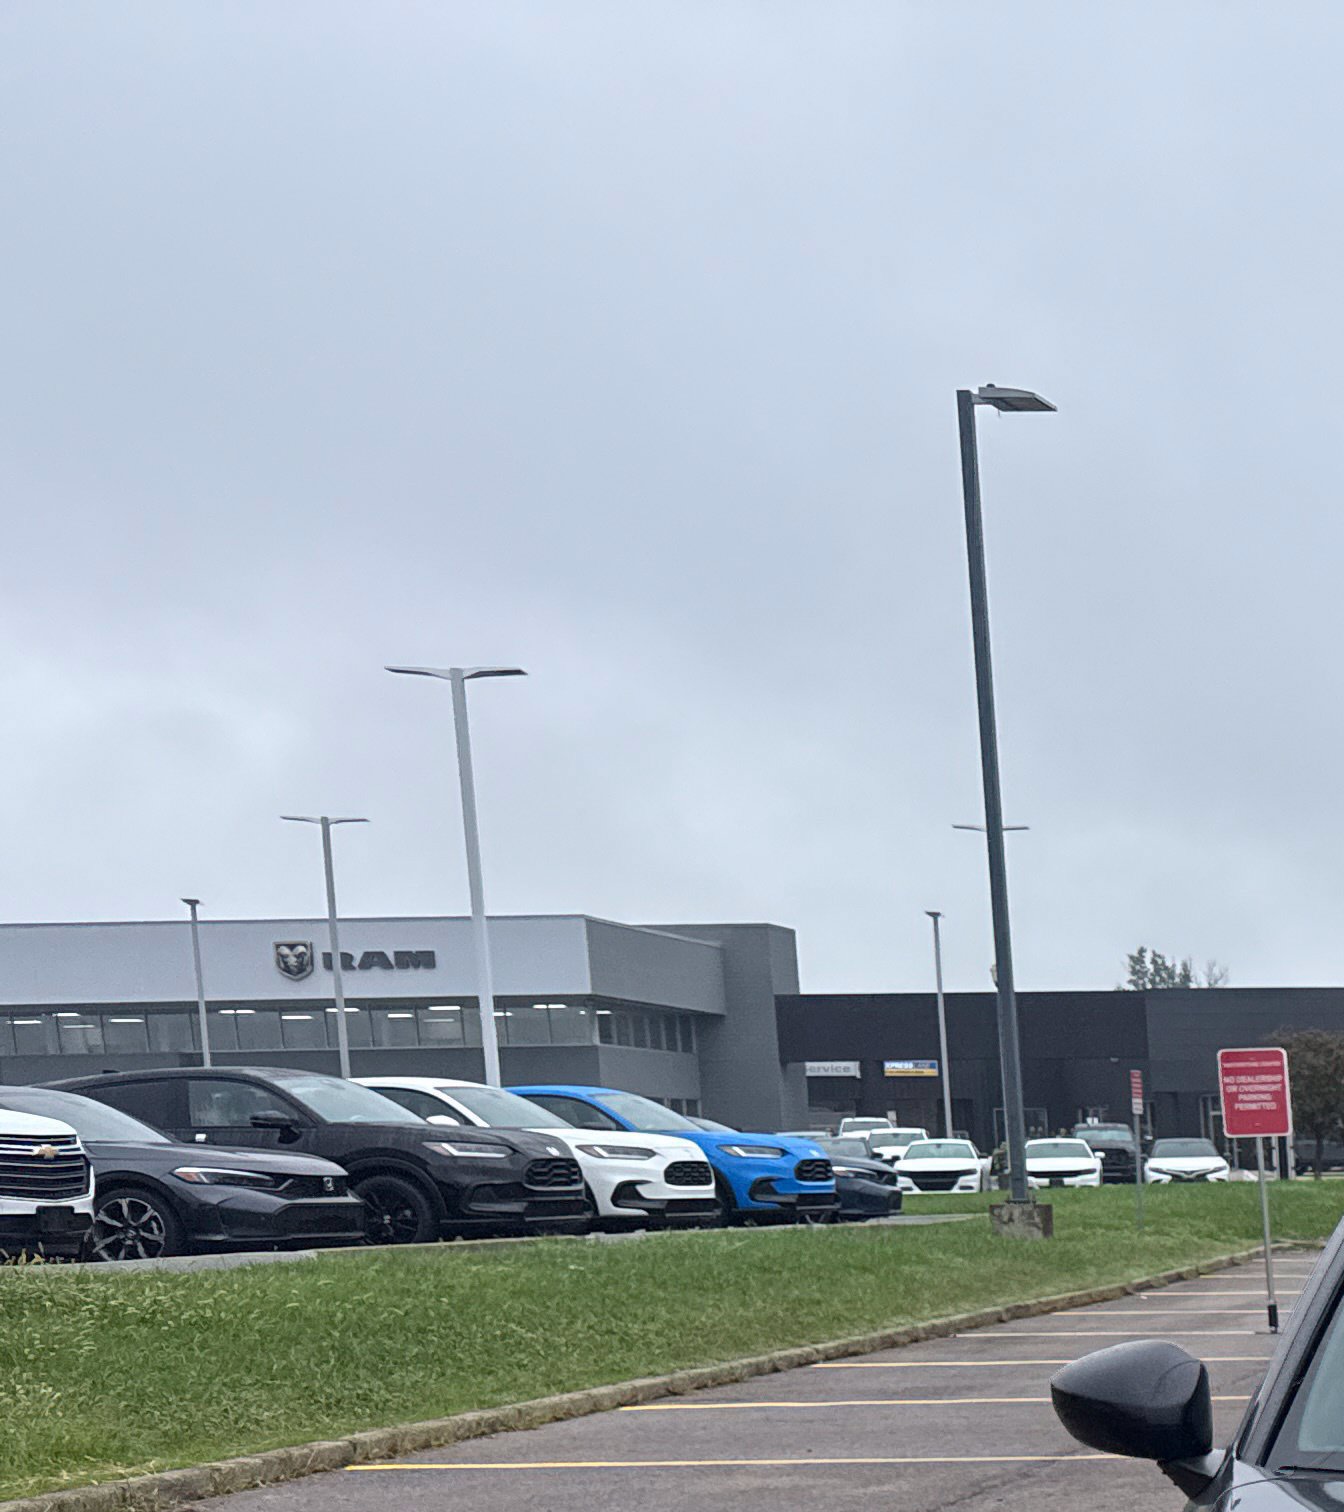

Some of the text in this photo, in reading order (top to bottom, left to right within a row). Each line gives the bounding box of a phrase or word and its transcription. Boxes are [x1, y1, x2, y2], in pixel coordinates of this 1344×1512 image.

[321, 950, 437, 971] RAM
[1223, 1075, 1235, 1084] NO
[1225, 1083, 1282, 1093] OR OVERNIGHT
[1238, 1093, 1273, 1101] PARKING
[1234, 1102, 1277, 1111] PERMITTED
